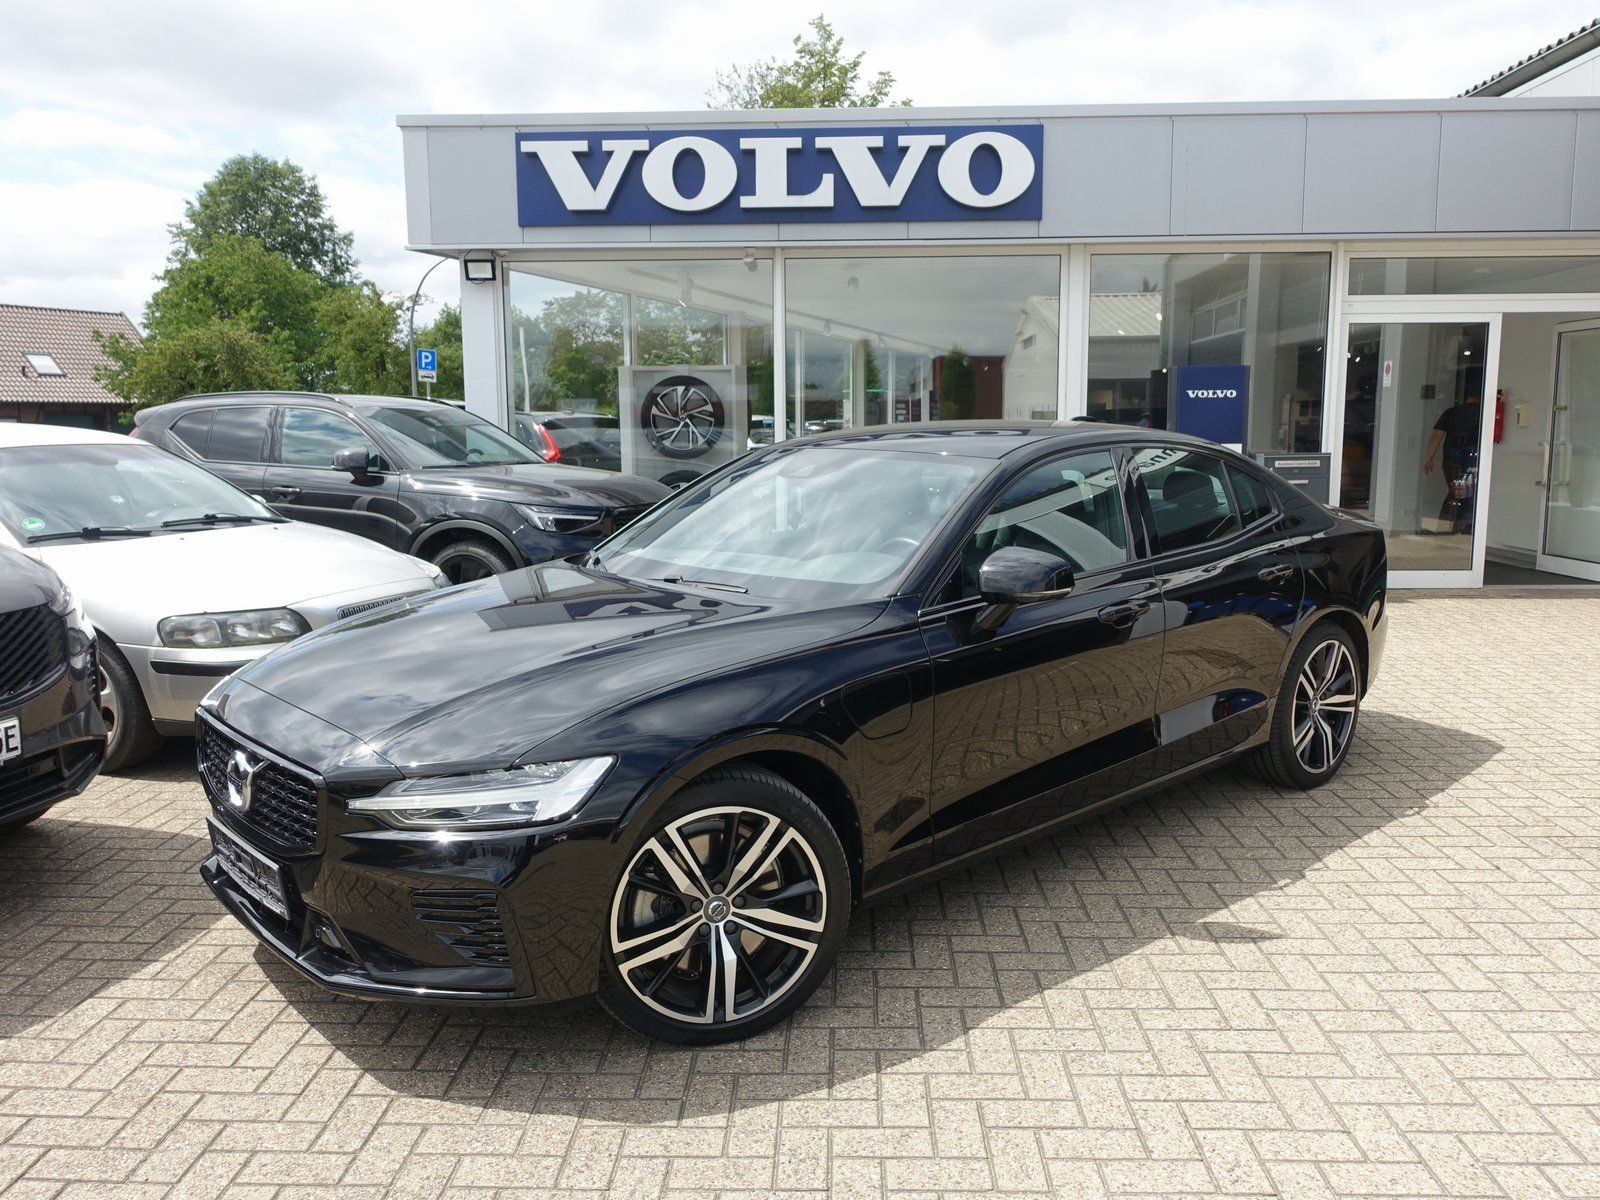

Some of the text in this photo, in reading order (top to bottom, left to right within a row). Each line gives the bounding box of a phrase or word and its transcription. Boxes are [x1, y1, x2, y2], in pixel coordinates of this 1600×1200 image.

[520, 131, 1036, 212] VOLVO
[421, 351, 432, 368] P
[1186, 389, 1237, 398] VOLVO
[0, 724, 19, 753] E
